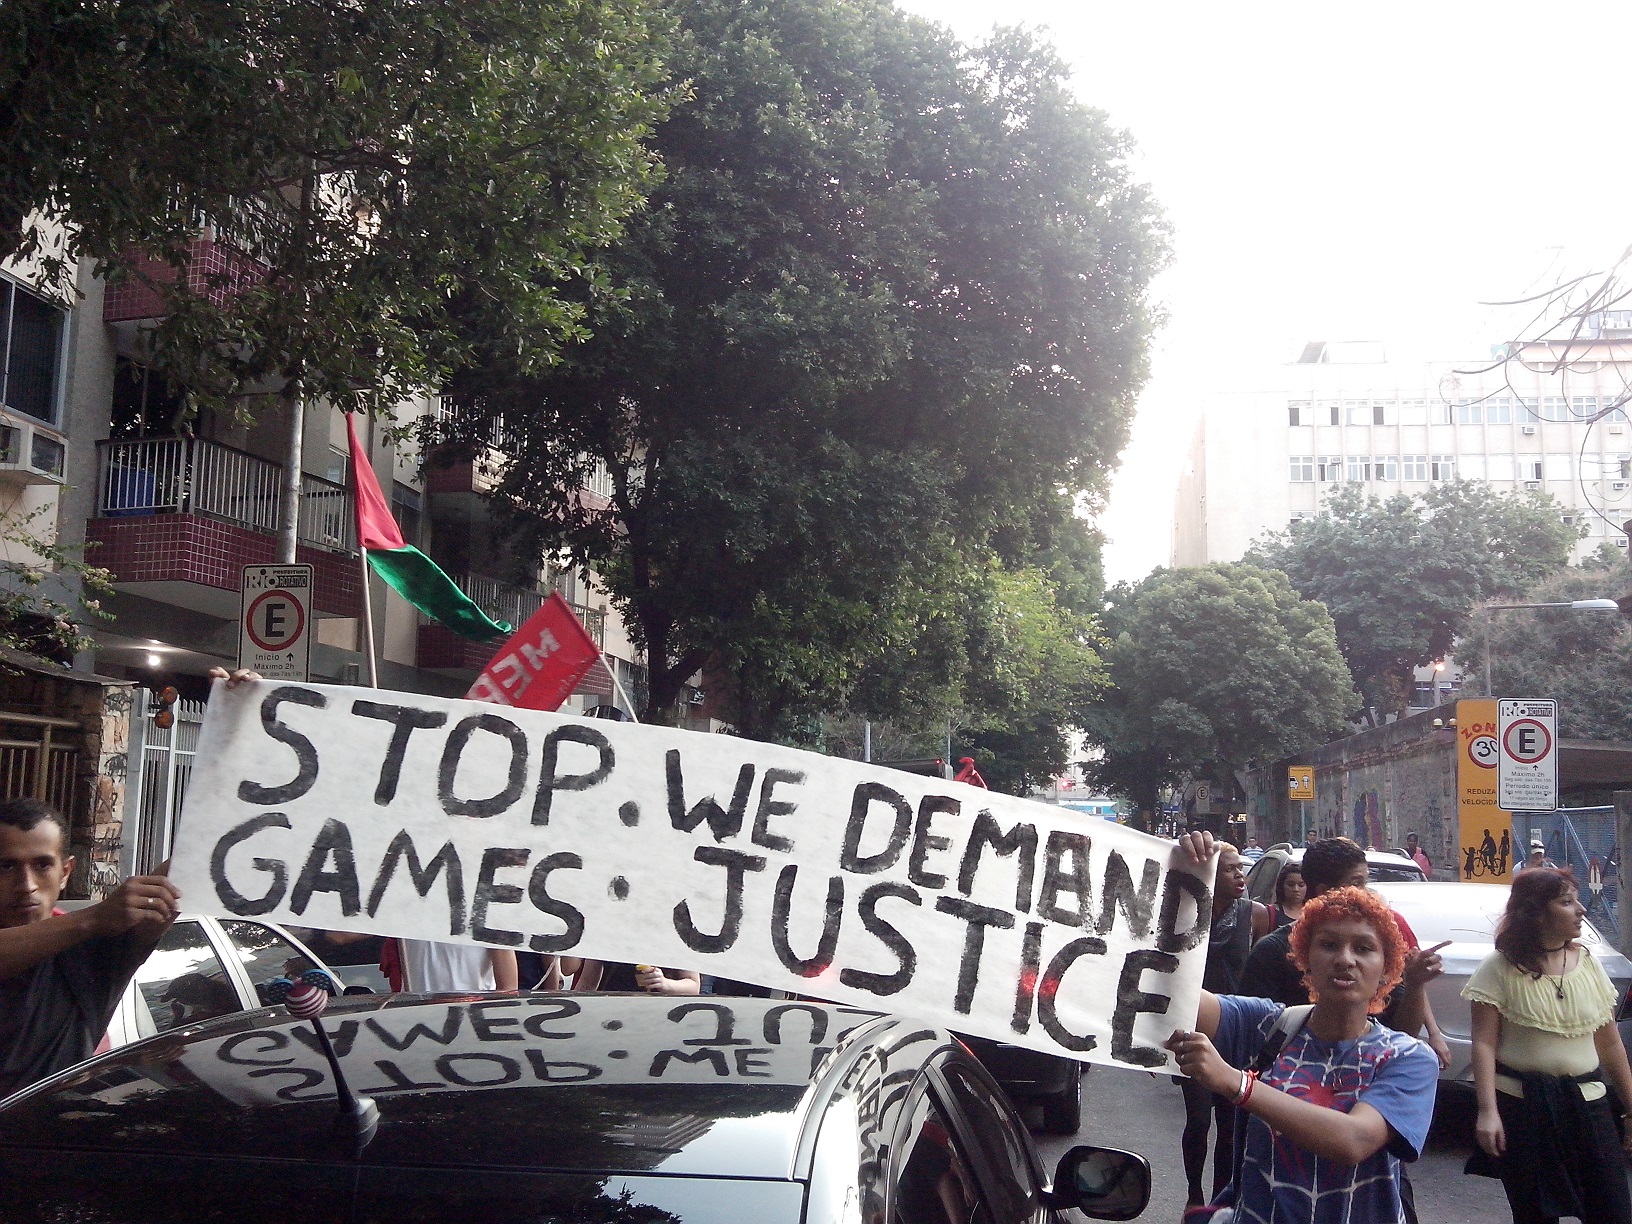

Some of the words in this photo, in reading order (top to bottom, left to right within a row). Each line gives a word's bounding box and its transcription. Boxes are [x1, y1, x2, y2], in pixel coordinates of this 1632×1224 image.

[265, 603, 286, 638] E
[1461, 722, 1497, 740] ZON
[1518, 728, 1536, 754] E
[666, 749, 809, 853] WE
[673, 846, 1180, 1067] JUSTICE
